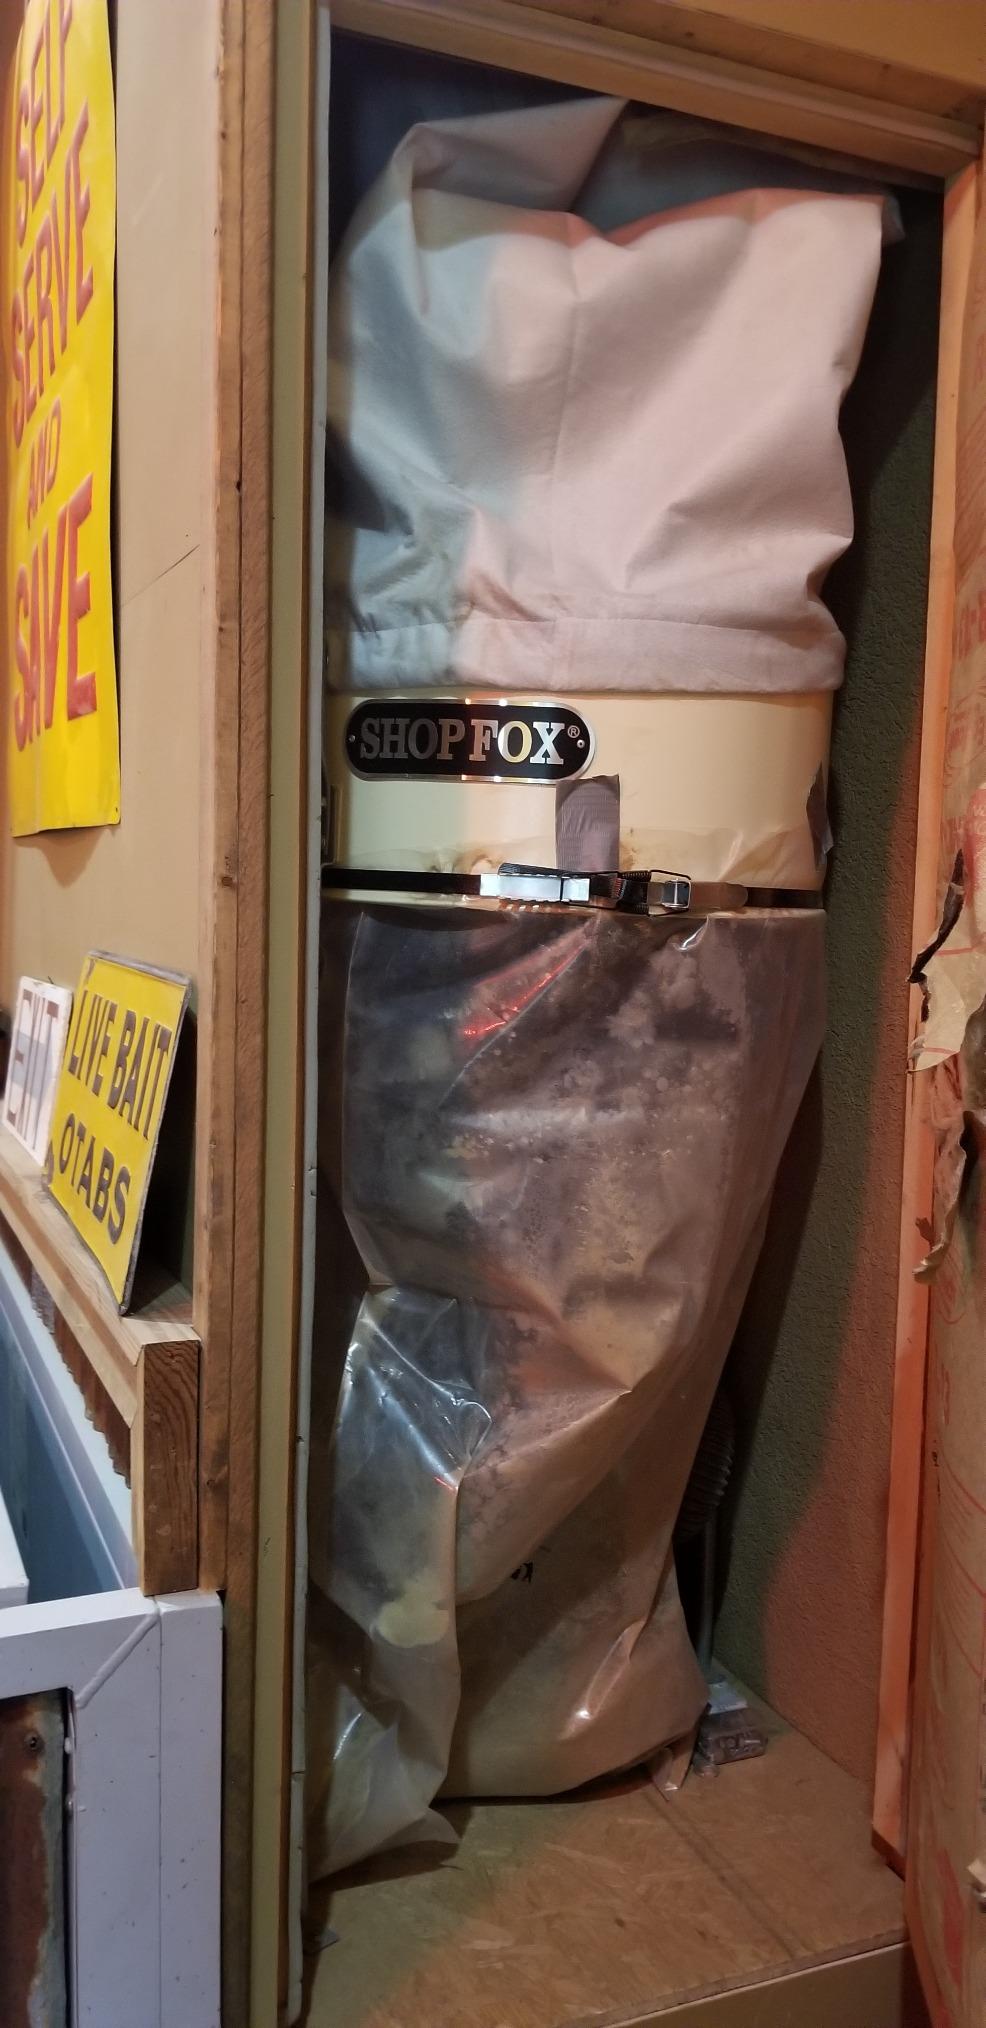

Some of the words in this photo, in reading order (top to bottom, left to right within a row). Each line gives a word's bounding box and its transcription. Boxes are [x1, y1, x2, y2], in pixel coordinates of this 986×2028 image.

[11, 96, 94, 450] SERVE
[27, 395, 61, 530] AND
[15, 472, 97, 752] SAVE
[359, 717, 466, 760] SHOP
[67, 989, 118, 1097] LIVE
[106, 1009, 172, 1141] BAIT
[58, 1112, 131, 1245] OTABS
